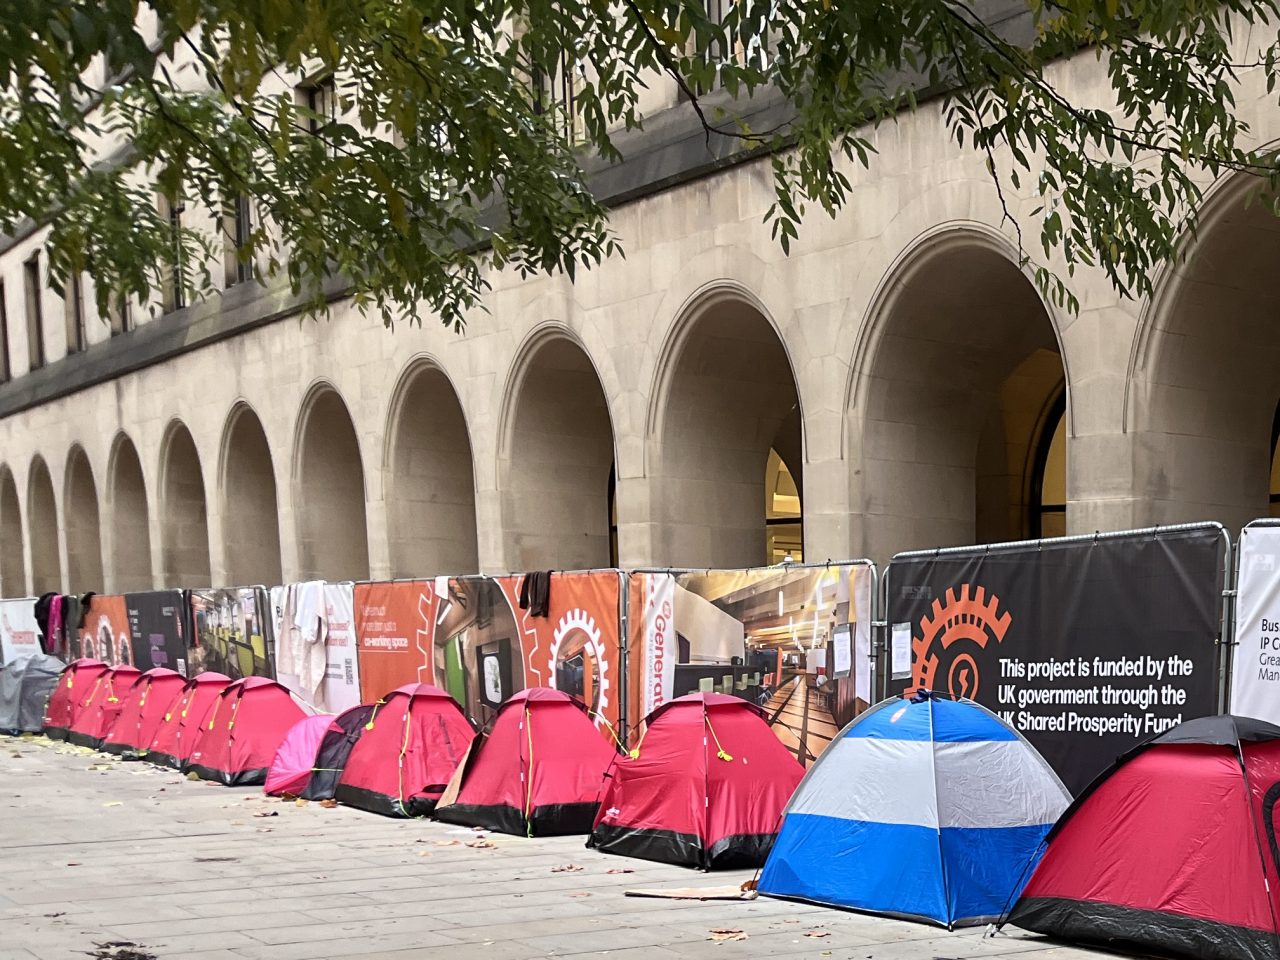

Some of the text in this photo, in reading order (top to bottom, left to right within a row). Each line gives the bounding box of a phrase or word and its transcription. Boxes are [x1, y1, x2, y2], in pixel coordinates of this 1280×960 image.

[1260, 636, 1270, 650] IP
[653, 614, 666, 711] Generat
[999, 655, 1193, 682] This project is funded by the
[998, 684, 1186, 710] UK government through the
[1018, 711, 1066, 732] Shared
[1068, 712, 1141, 738] Prosperity
